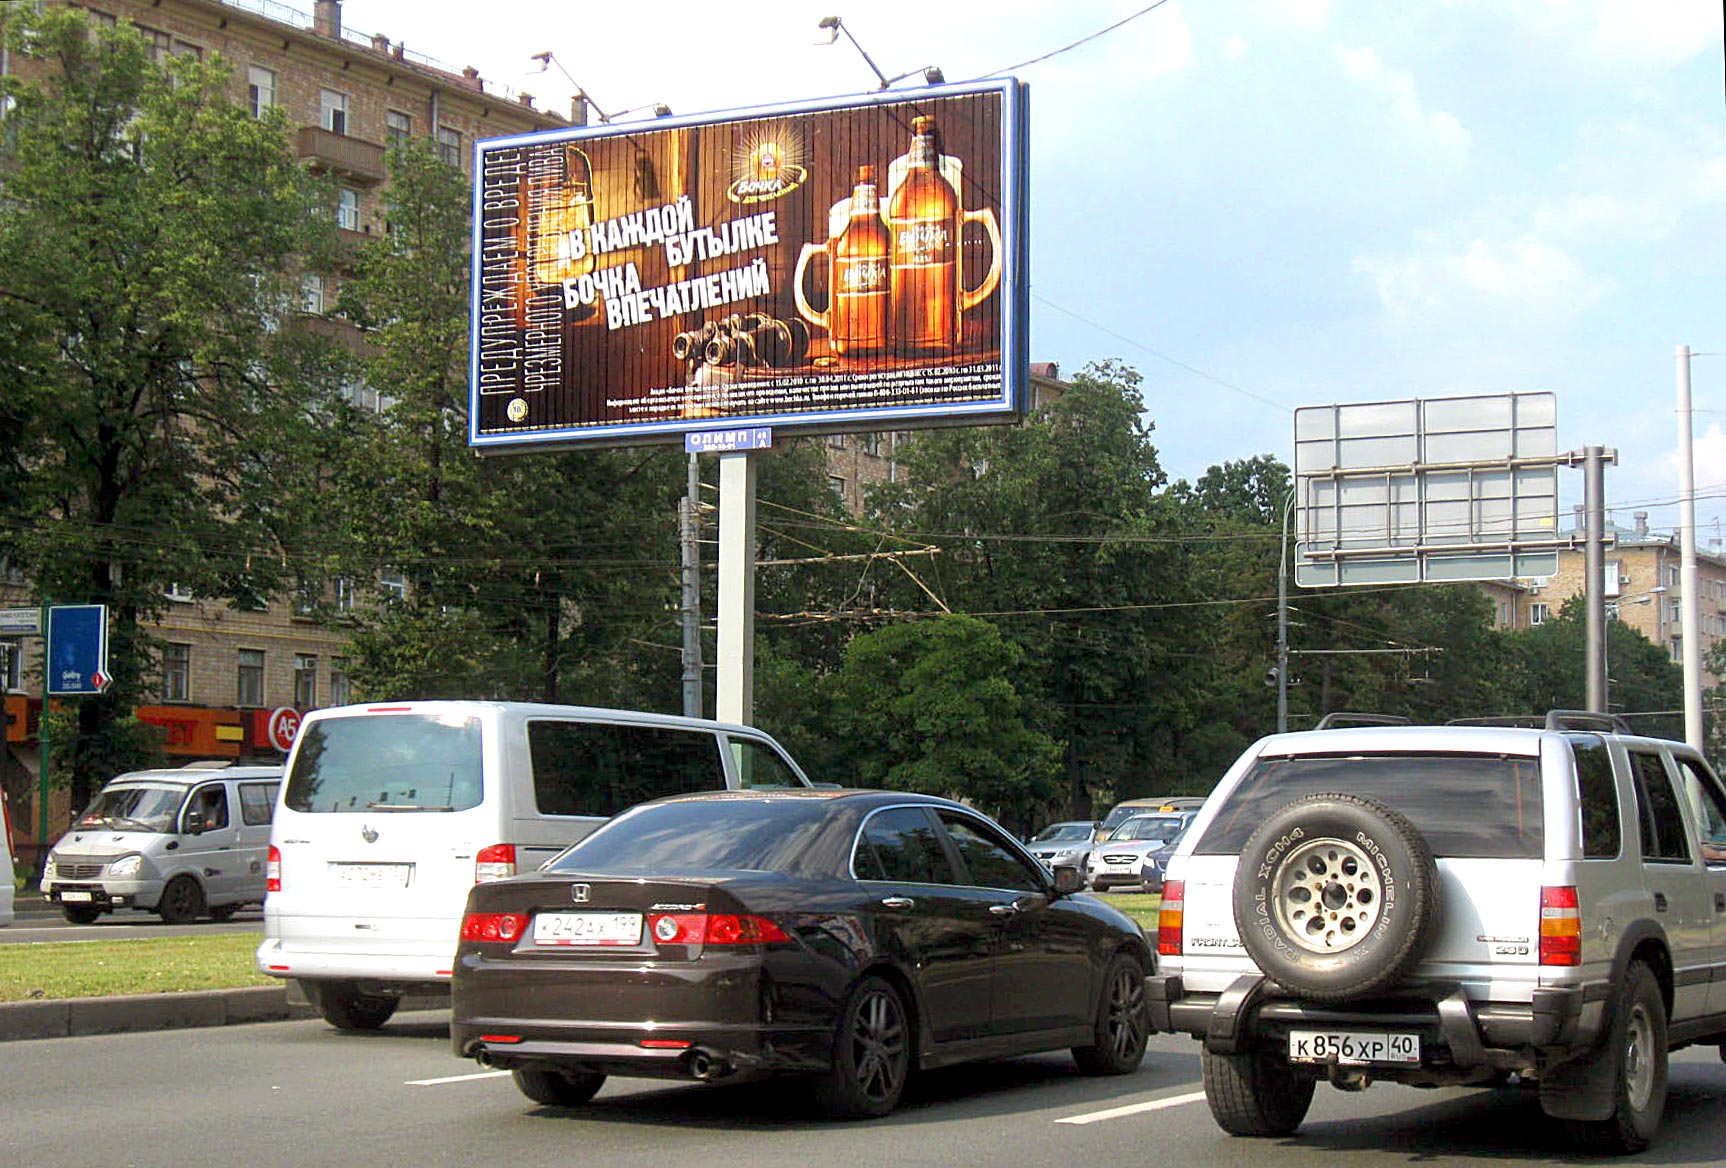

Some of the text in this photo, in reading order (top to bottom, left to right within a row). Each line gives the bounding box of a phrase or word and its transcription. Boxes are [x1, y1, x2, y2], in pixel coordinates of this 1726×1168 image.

[528, 147, 564, 185] ПИВА
[590, 195, 694, 255] КАЖДОЙ
[664, 211, 779, 267] БУТЫЛКЕ
[480, 153, 527, 395] ПРЕДУПРЕЖДАЕМ О ВРЕДЕ
[562, 262, 642, 310] БОЧКА
[606, 257, 770, 330] ВПЕЧАТЛЕНИЙ
[524, 295, 562, 392] ЧРЕЗМЕРНОГО
[690, 431, 747, 445] ОЛИМП
[1356, 831, 1395, 940] MICHELIN
[1391, 1036, 1413, 1054] 40
